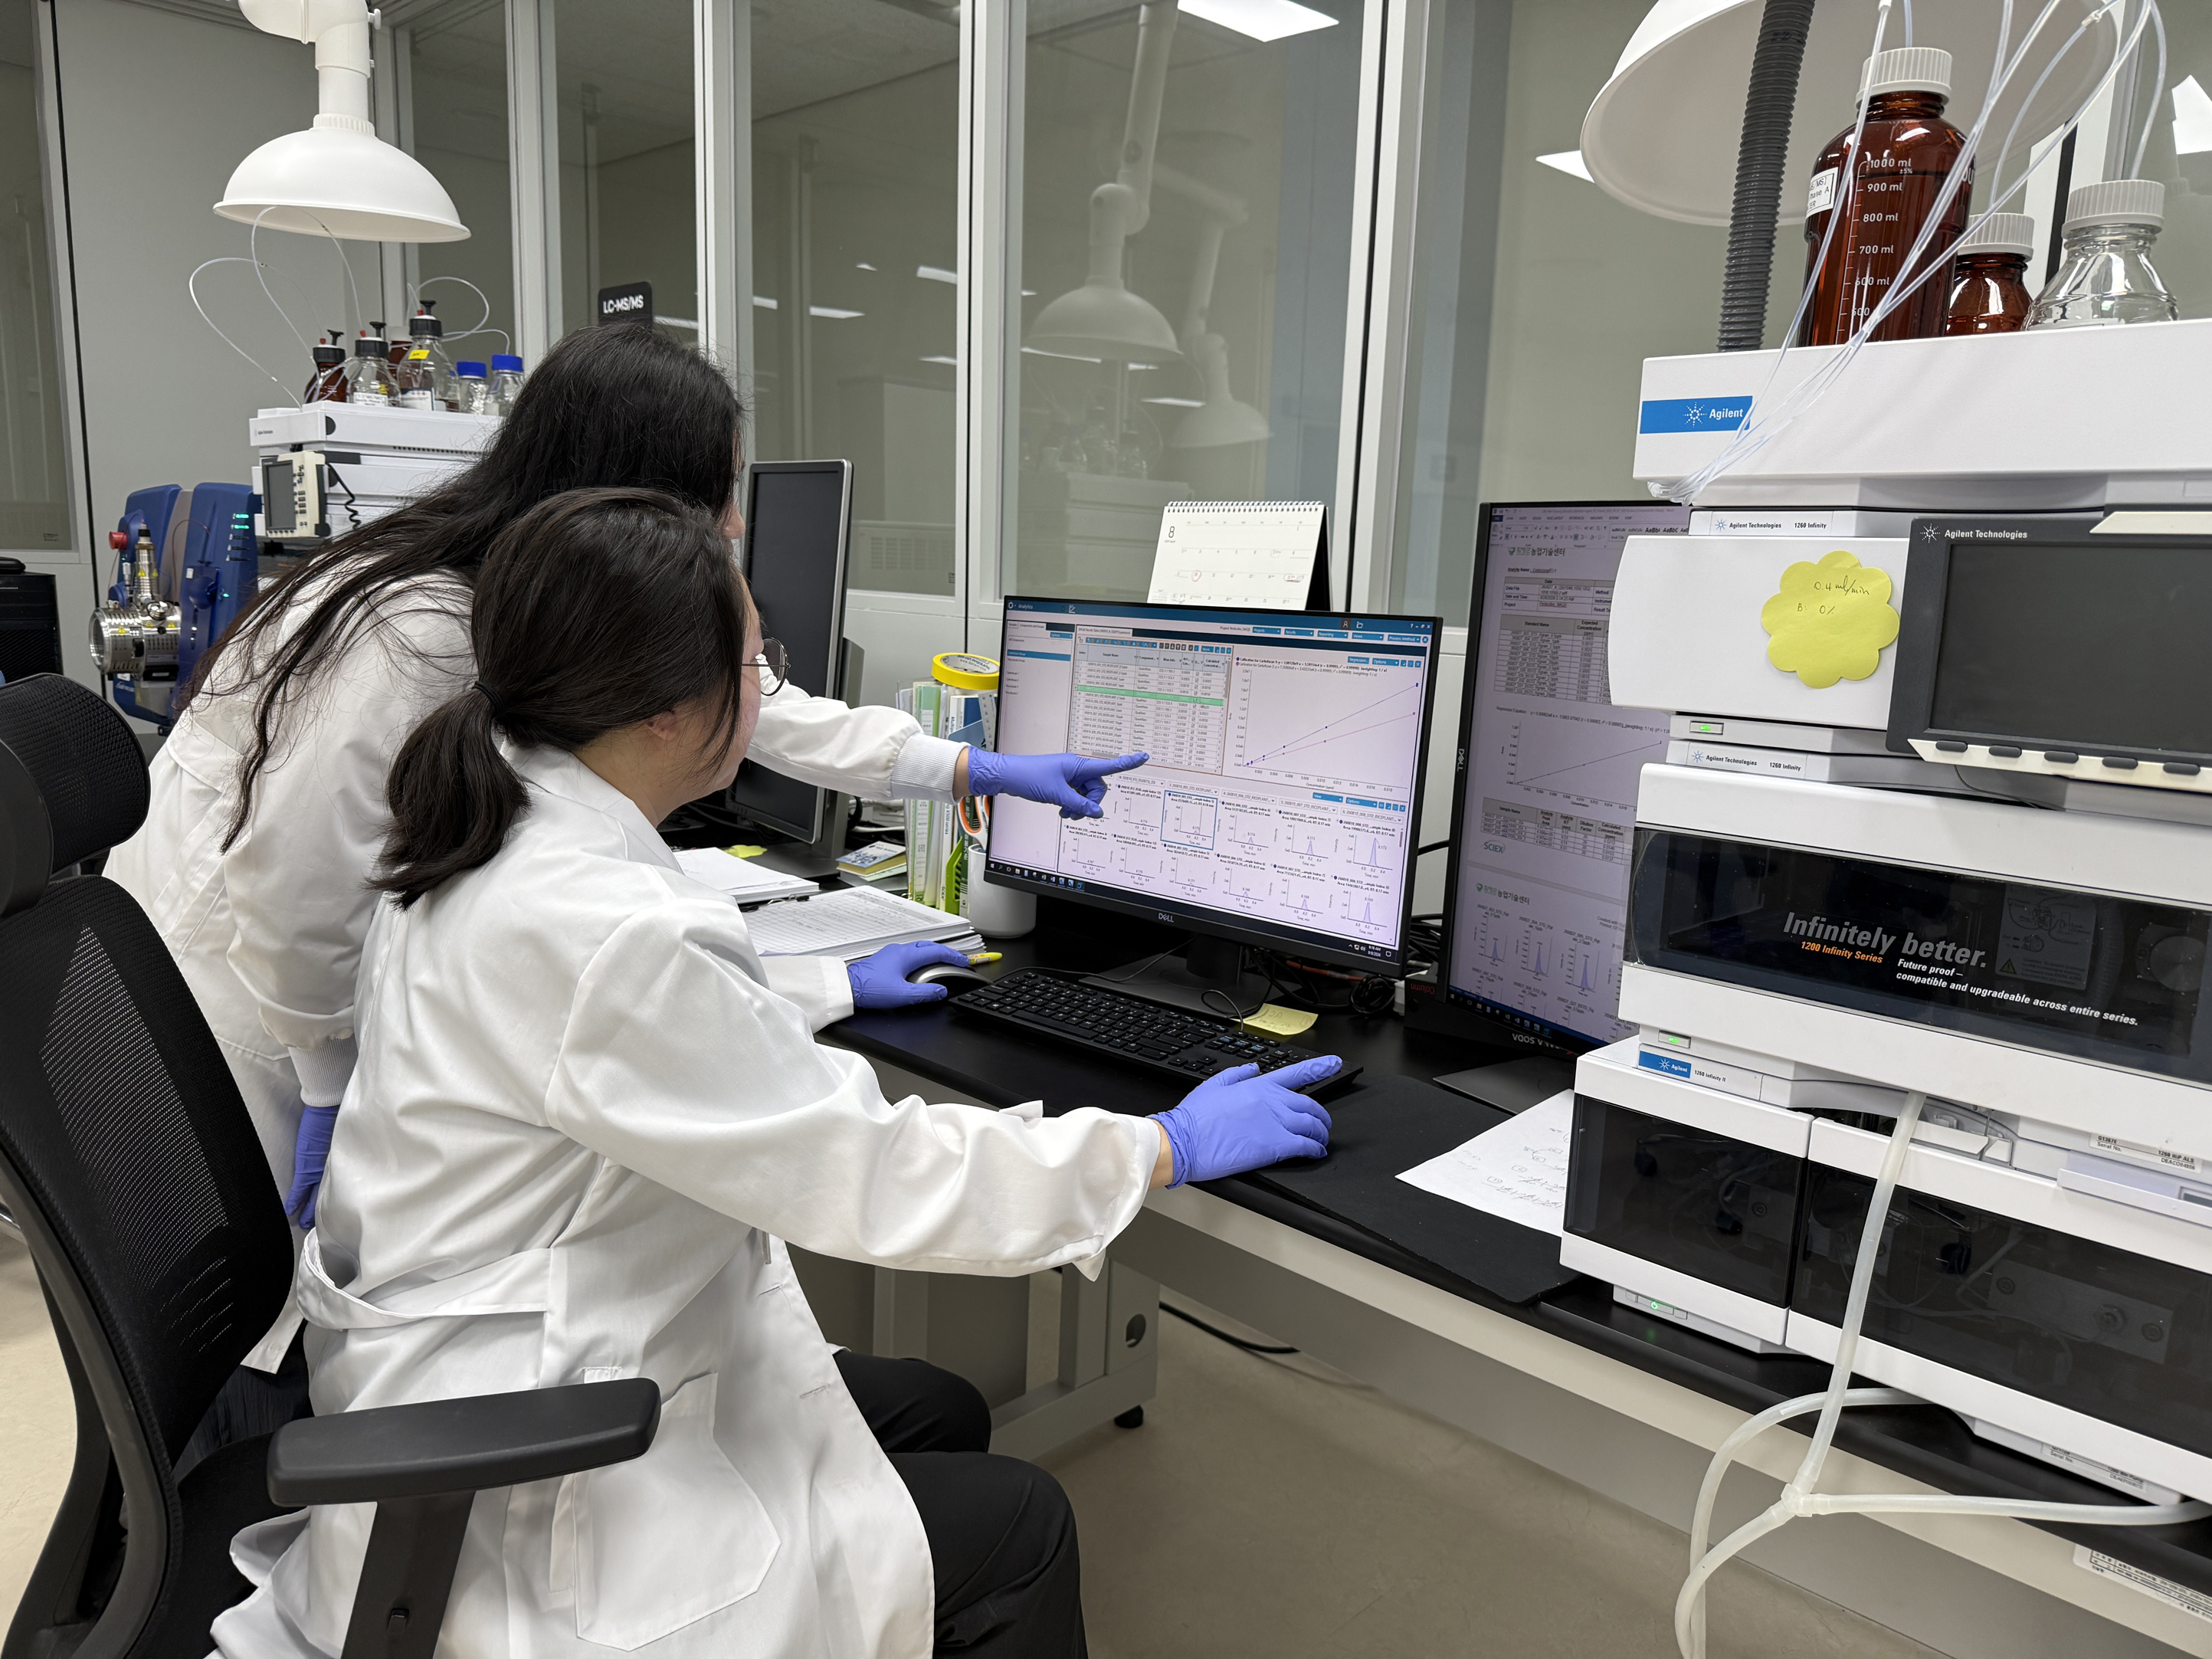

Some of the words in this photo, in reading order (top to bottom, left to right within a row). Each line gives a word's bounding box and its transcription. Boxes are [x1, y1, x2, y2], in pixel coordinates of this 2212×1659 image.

[1870, 159, 1895, 169] 1000
[1898, 159, 1911, 167] ml
[1867, 183, 1886, 192] 900
[1889, 182, 1902, 191] ml
[1863, 214, 1883, 223] 800
[1885, 213, 1899, 221] ml
[1859, 246, 1879, 254] 700
[1881, 245, 1894, 254] ml
[1855, 277, 1874, 286] 600
[1877, 277, 1889, 285] ml
[602, 294, 644, 314] LC-MS/MS
[1709, 408, 1743, 420] Agilent
[1168, 526, 1175, 538] 8
[1807, 522, 1827, 530] Infinity
[1944, 530, 1973, 539] Agilent
[1975, 530, 2027, 539] Technologies
[1531, 548, 1565, 556] 농업기술센터
[1457, 748, 1465, 772] DELL
[1725, 757, 1757, 766] Technologies
[1782, 763, 1801, 772] Infinity
[1598, 828, 1624, 836] Concentration
[1601, 822, 1620, 831] Calculated
[1483, 842, 1504, 854] SCIEX
[1498, 890, 1529, 905] 농업기술센터
[1158, 913, 1174, 923] DELL
[1784, 912, 1896, 955] Infinitely
[1902, 937, 1987, 969] better.
[1801, 941, 1820, 953] 1200
[1821, 945, 1853, 959] Infinity
[1854, 951, 1883, 963] Series
[1897, 959, 1927, 972] Future
[1929, 966, 1955, 979] proof
[1411, 982, 1435, 995] Column
[1896, 972, 1947, 989] compatible
[1949, 980, 1968, 992] and
[1970, 984, 2030, 1005] upgradeable
[2033, 998, 2067, 1011] across
[2069, 1005, 2100, 1018] entire
[2102, 1010, 2138, 1025] series.
[1671, 1064, 1687, 1073] Agilent
[1706, 1073, 1722, 1081] Infinity
[2050, 1451, 2064, 1460] Serial
